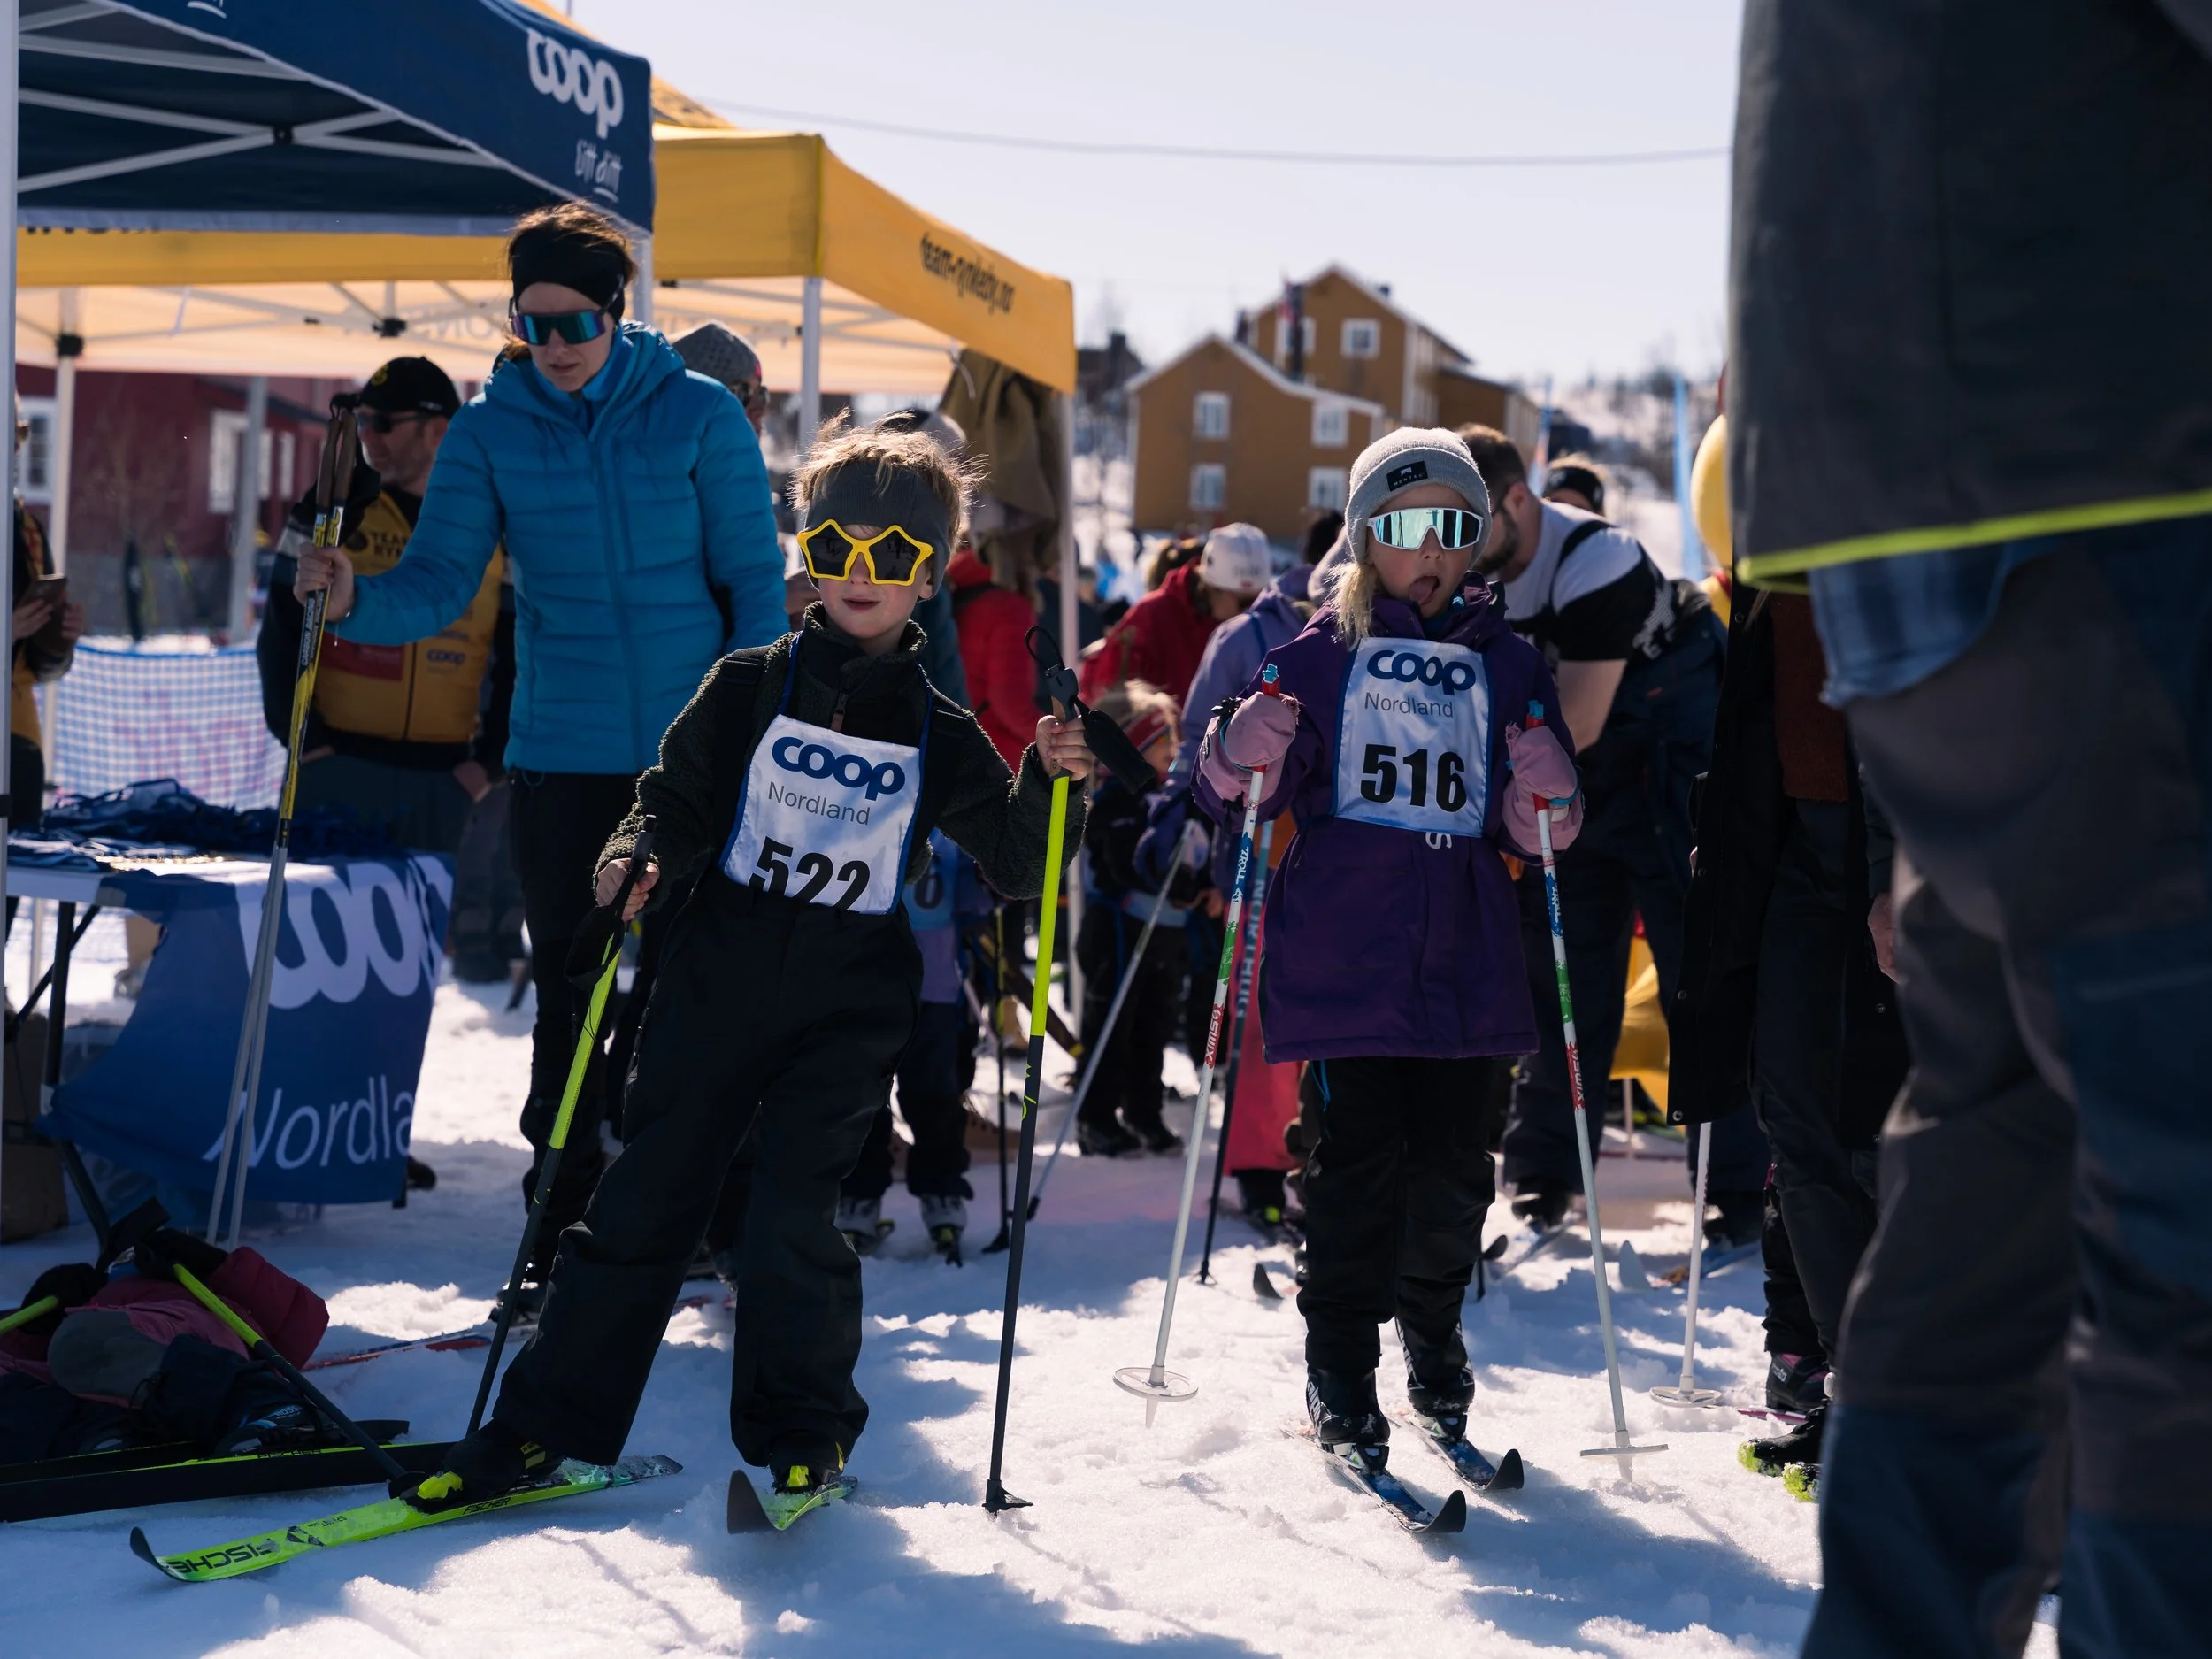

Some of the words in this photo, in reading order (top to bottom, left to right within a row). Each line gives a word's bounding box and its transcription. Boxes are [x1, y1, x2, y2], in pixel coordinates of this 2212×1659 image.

[527, 28, 624, 141] coop
[1366, 649, 1476, 696] coop
[1364, 692, 1454, 718] Nordland
[772, 736, 906, 802] coop
[1360, 743, 1468, 813] 516
[768, 781, 871, 826] Nordland
[748, 835, 871, 911] 522
[462, 1497, 511, 1516] FISCHER
[166, 1537, 278, 1574] FISCHE
